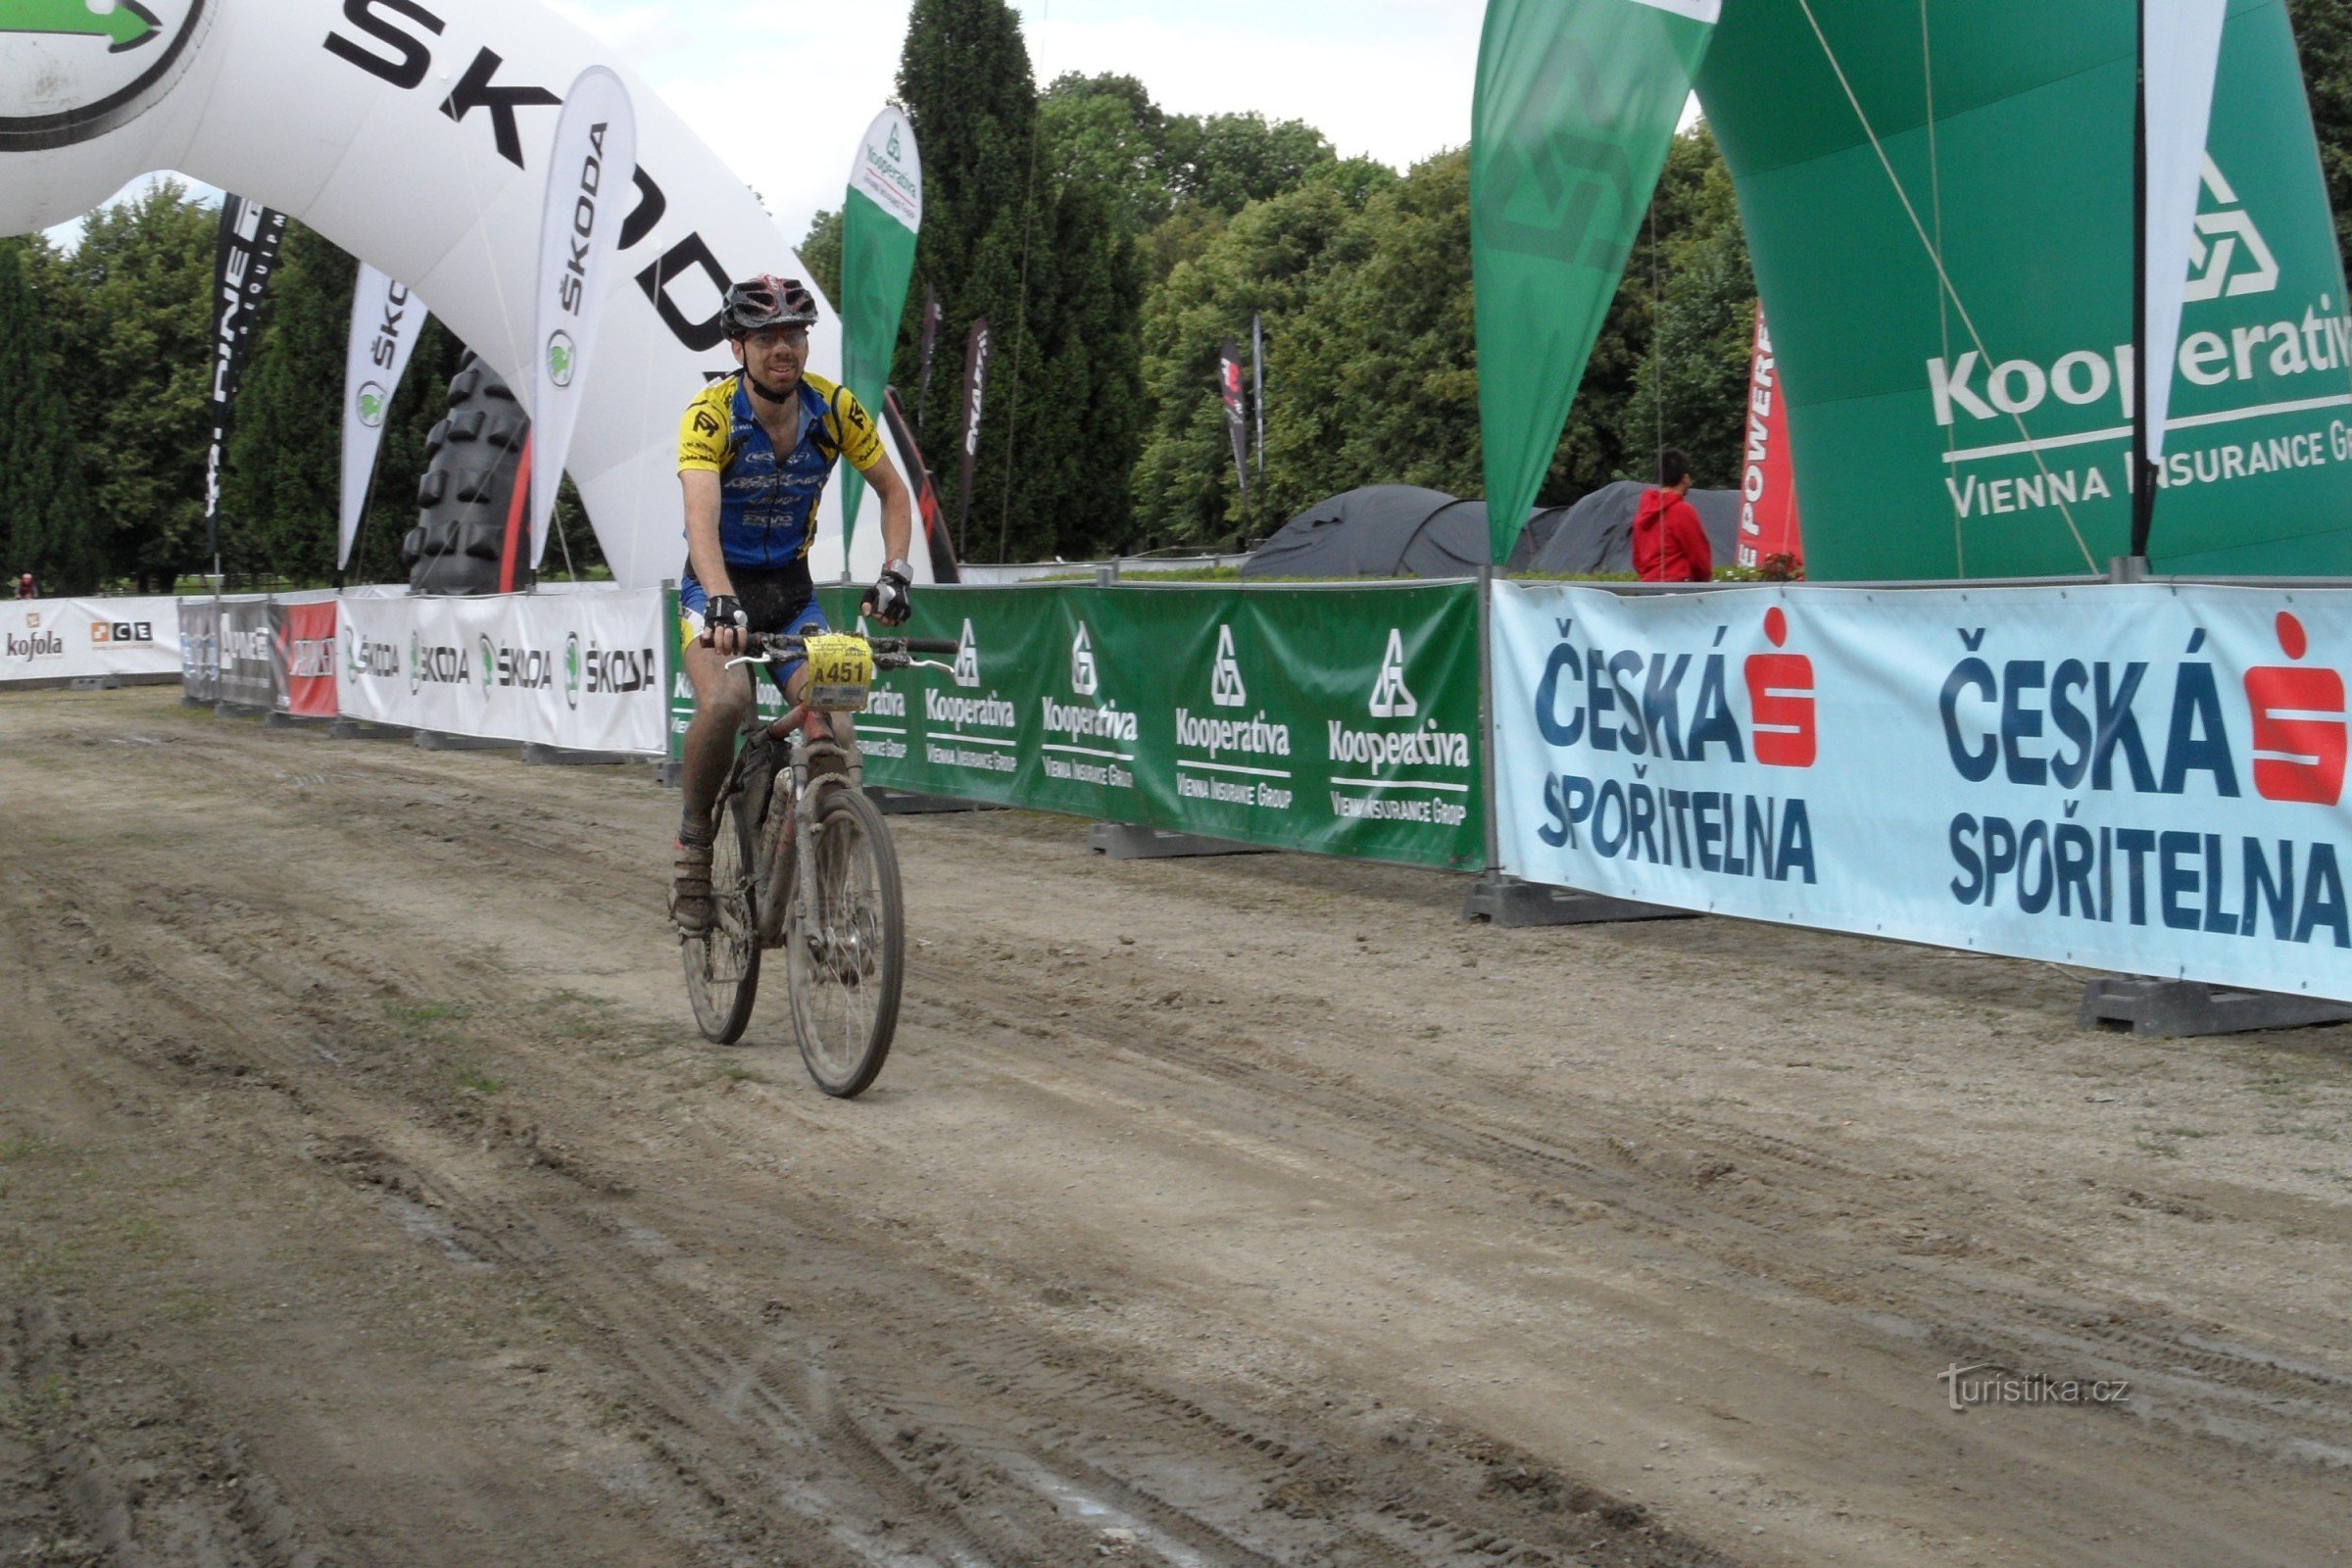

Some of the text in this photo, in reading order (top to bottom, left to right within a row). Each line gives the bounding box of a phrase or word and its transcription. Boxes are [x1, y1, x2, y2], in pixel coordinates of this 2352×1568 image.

[559, 122, 608, 317] ŠKODA
[1945, 466, 2111, 518] VIENNA
[6, 630, 63, 662] kofola
[925, 688, 1016, 732] Kooperativa
[1535, 617, 1746, 762] ČESKÁ
[1939, 627, 2241, 798] ČESKÁ
[1042, 696, 1138, 743] Kooperativa
[1176, 708, 1291, 760] Kooperativa
[1328, 717, 1470, 775] Kooperativa
[1537, 762, 1818, 885] SPOŘITELNA
[1948, 799, 2352, 949] SPOŘITELNA
